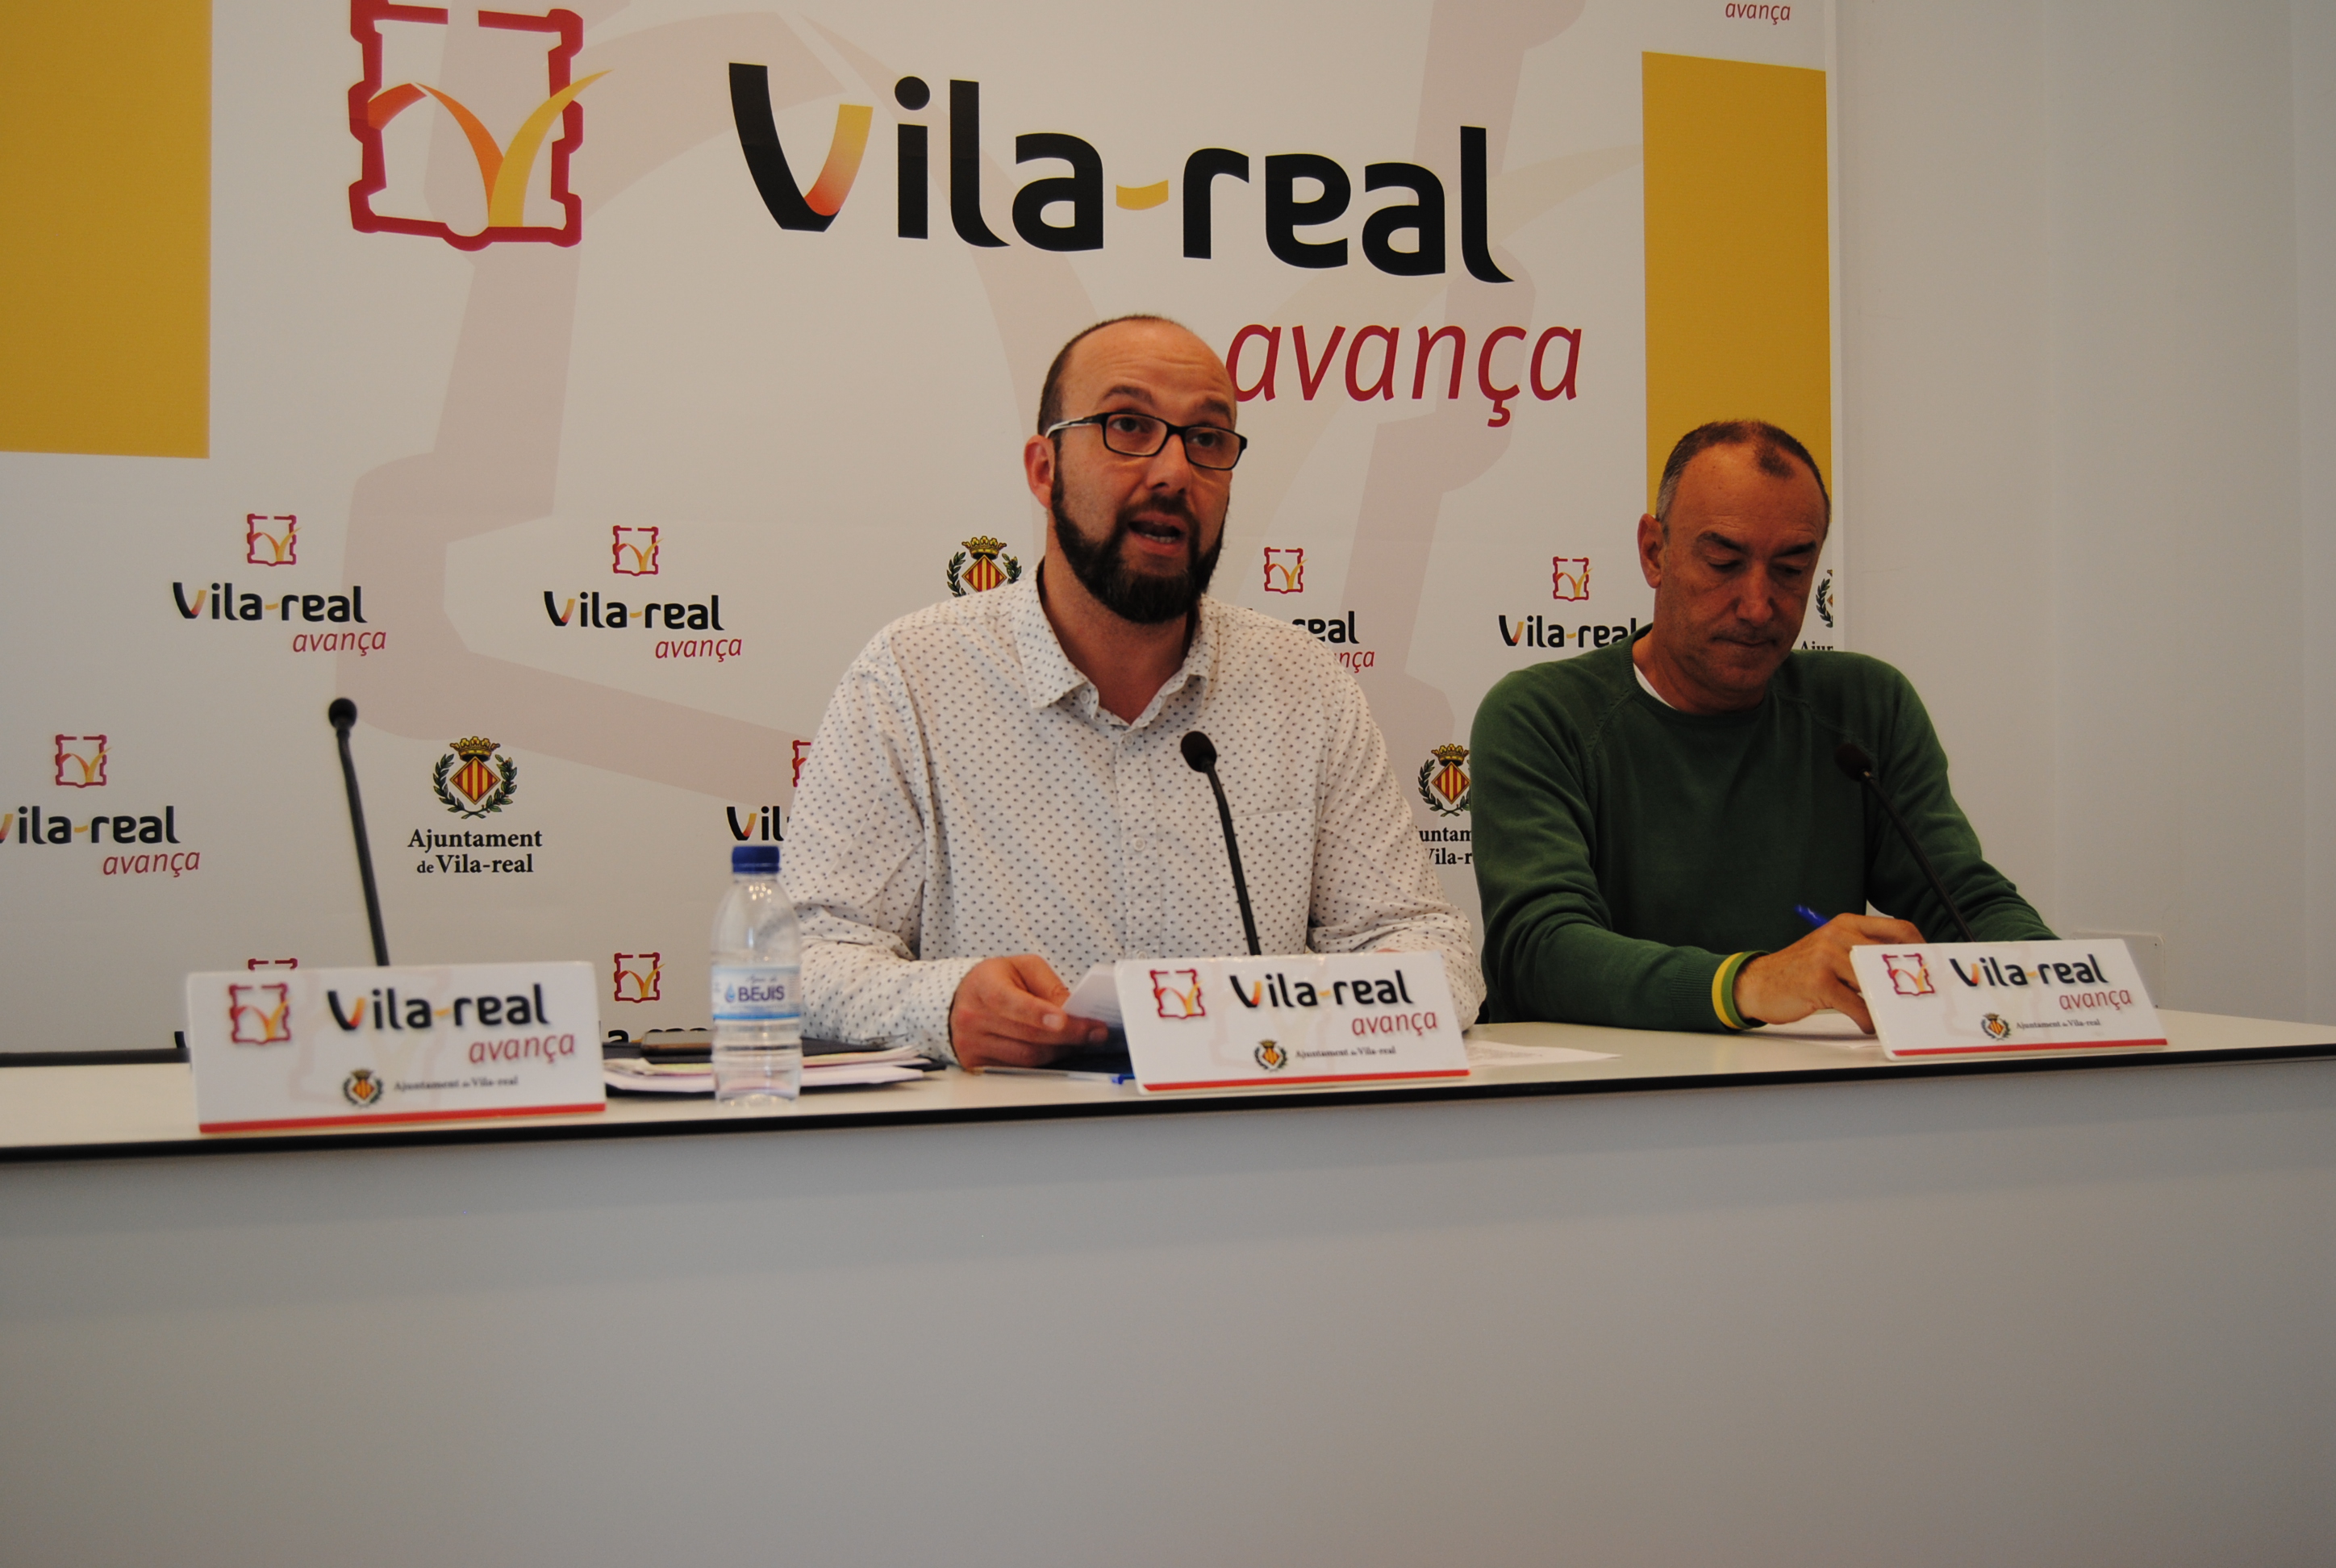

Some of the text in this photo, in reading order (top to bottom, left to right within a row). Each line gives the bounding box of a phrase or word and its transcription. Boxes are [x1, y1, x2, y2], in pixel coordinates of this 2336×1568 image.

[1725, 2, 1791, 25] avança
[728, 62, 1514, 283] Vila-real
[1225, 323, 1583, 427] avança
[173, 582, 368, 623] Vila-real
[544, 590, 725, 631] Vila-real
[292, 631, 387, 657] avança
[655, 638, 743, 663] avança
[1334, 650, 1375, 673] nça
[407, 828, 543, 853] Ajuntament
[102, 851, 201, 878] avança
[416, 853, 535, 874] de Vila-real
[1949, 953, 2110, 987] Vila-real
[737, 985, 785, 1002] BEJIS
[1228, 970, 1415, 1009] Vila-real
[2059, 989, 2133, 1011] avança
[327, 982, 553, 1032] Vila-real
[1351, 1011, 1439, 1037] avança
[468, 1032, 576, 1064] avança
